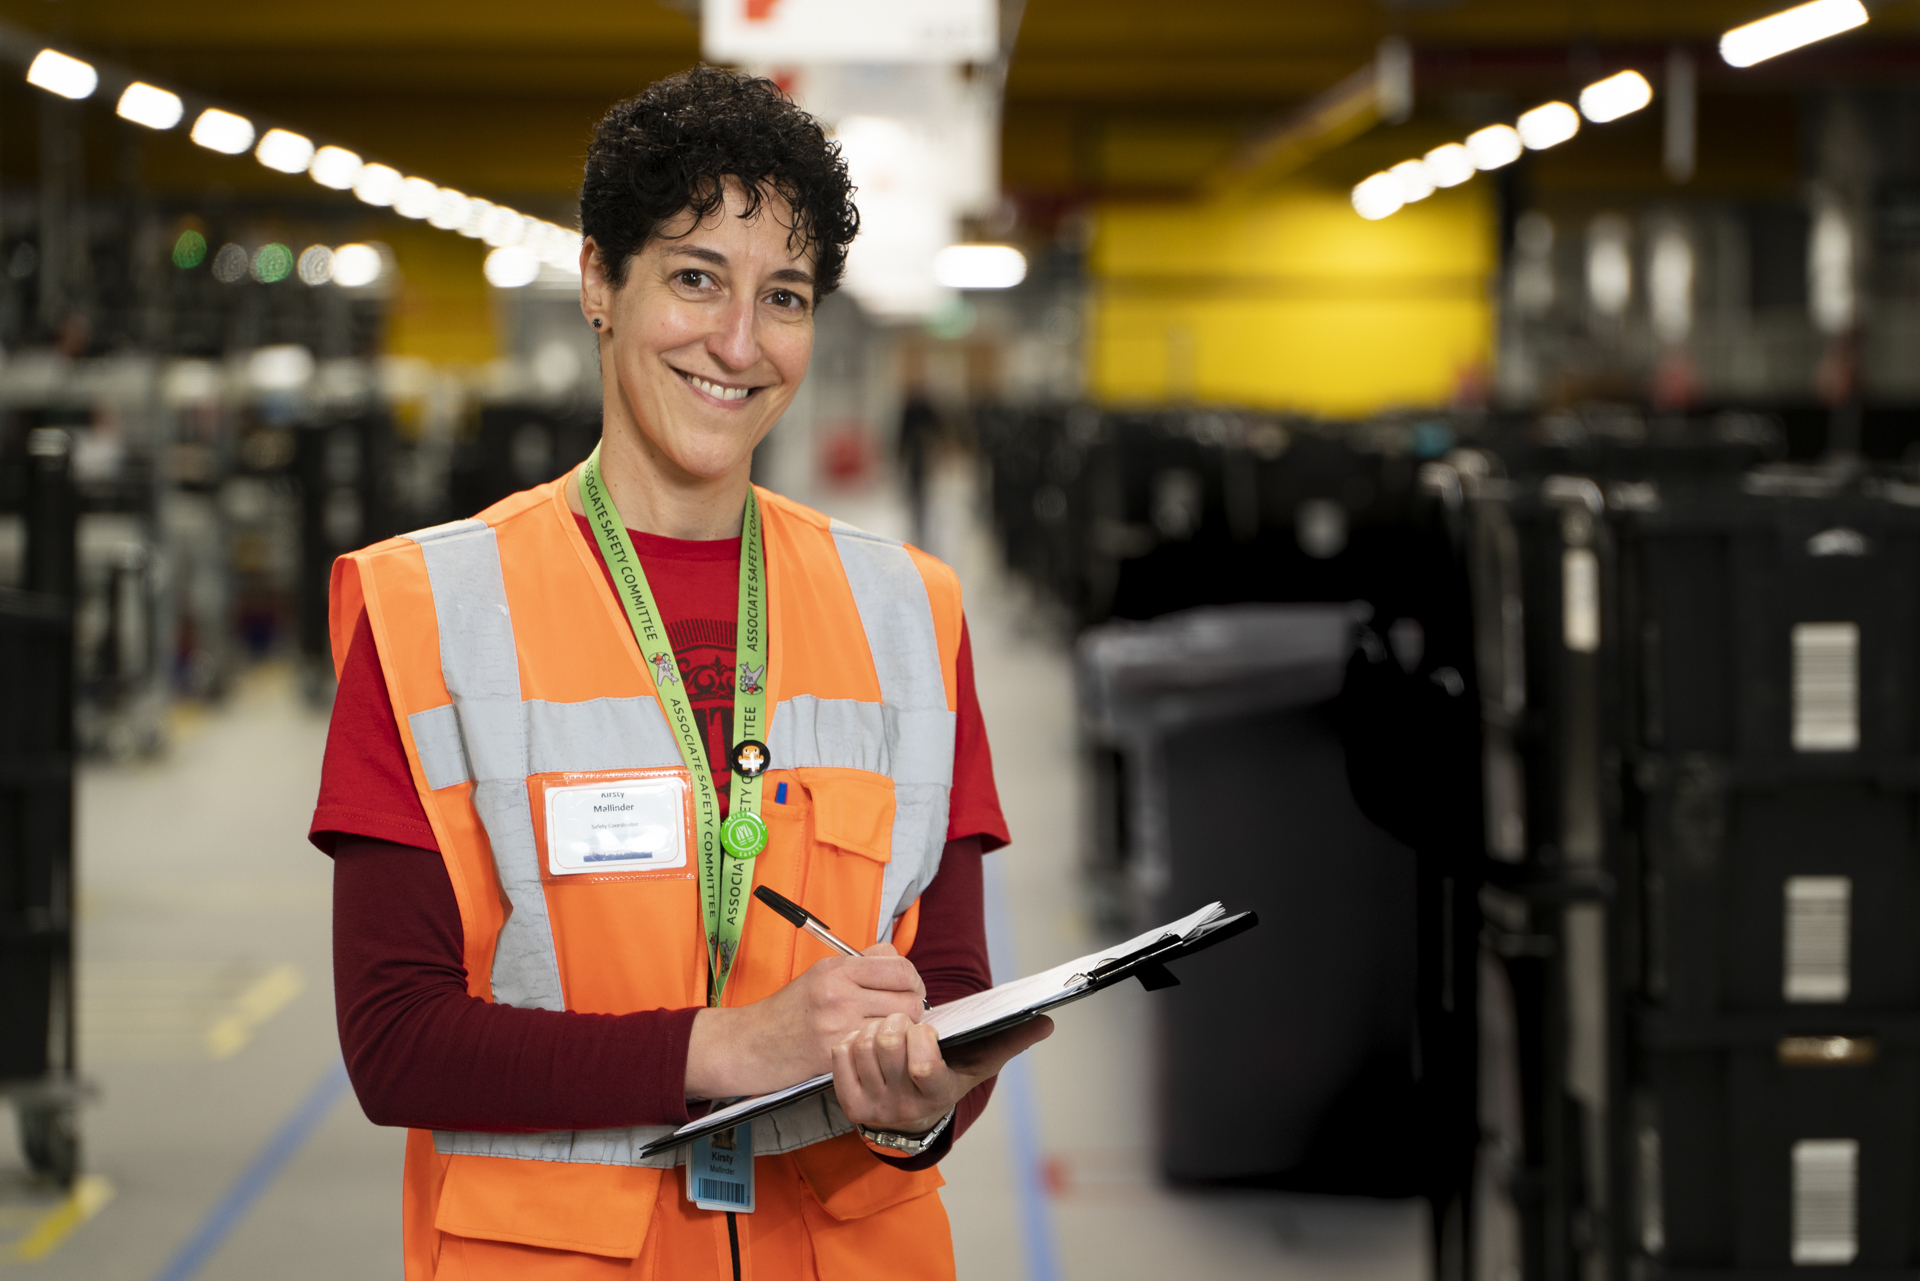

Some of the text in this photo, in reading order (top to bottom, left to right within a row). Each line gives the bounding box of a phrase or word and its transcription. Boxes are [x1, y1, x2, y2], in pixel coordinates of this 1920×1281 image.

[585, 460, 659, 642] ASSOCIATE SAFETY COMMITTEE
[747, 537, 758, 582] SAFETY
[747, 583, 758, 652] ASSOCIATE
[593, 803, 635, 813] Mallinder
[670, 697, 716, 918] ASSOCIATE SAFETY COMMITTEE
[738, 843, 763, 857] SAFETY
[710, 1165, 735, 1175] Mallinder
[712, 1152, 734, 1165] Kirsty
